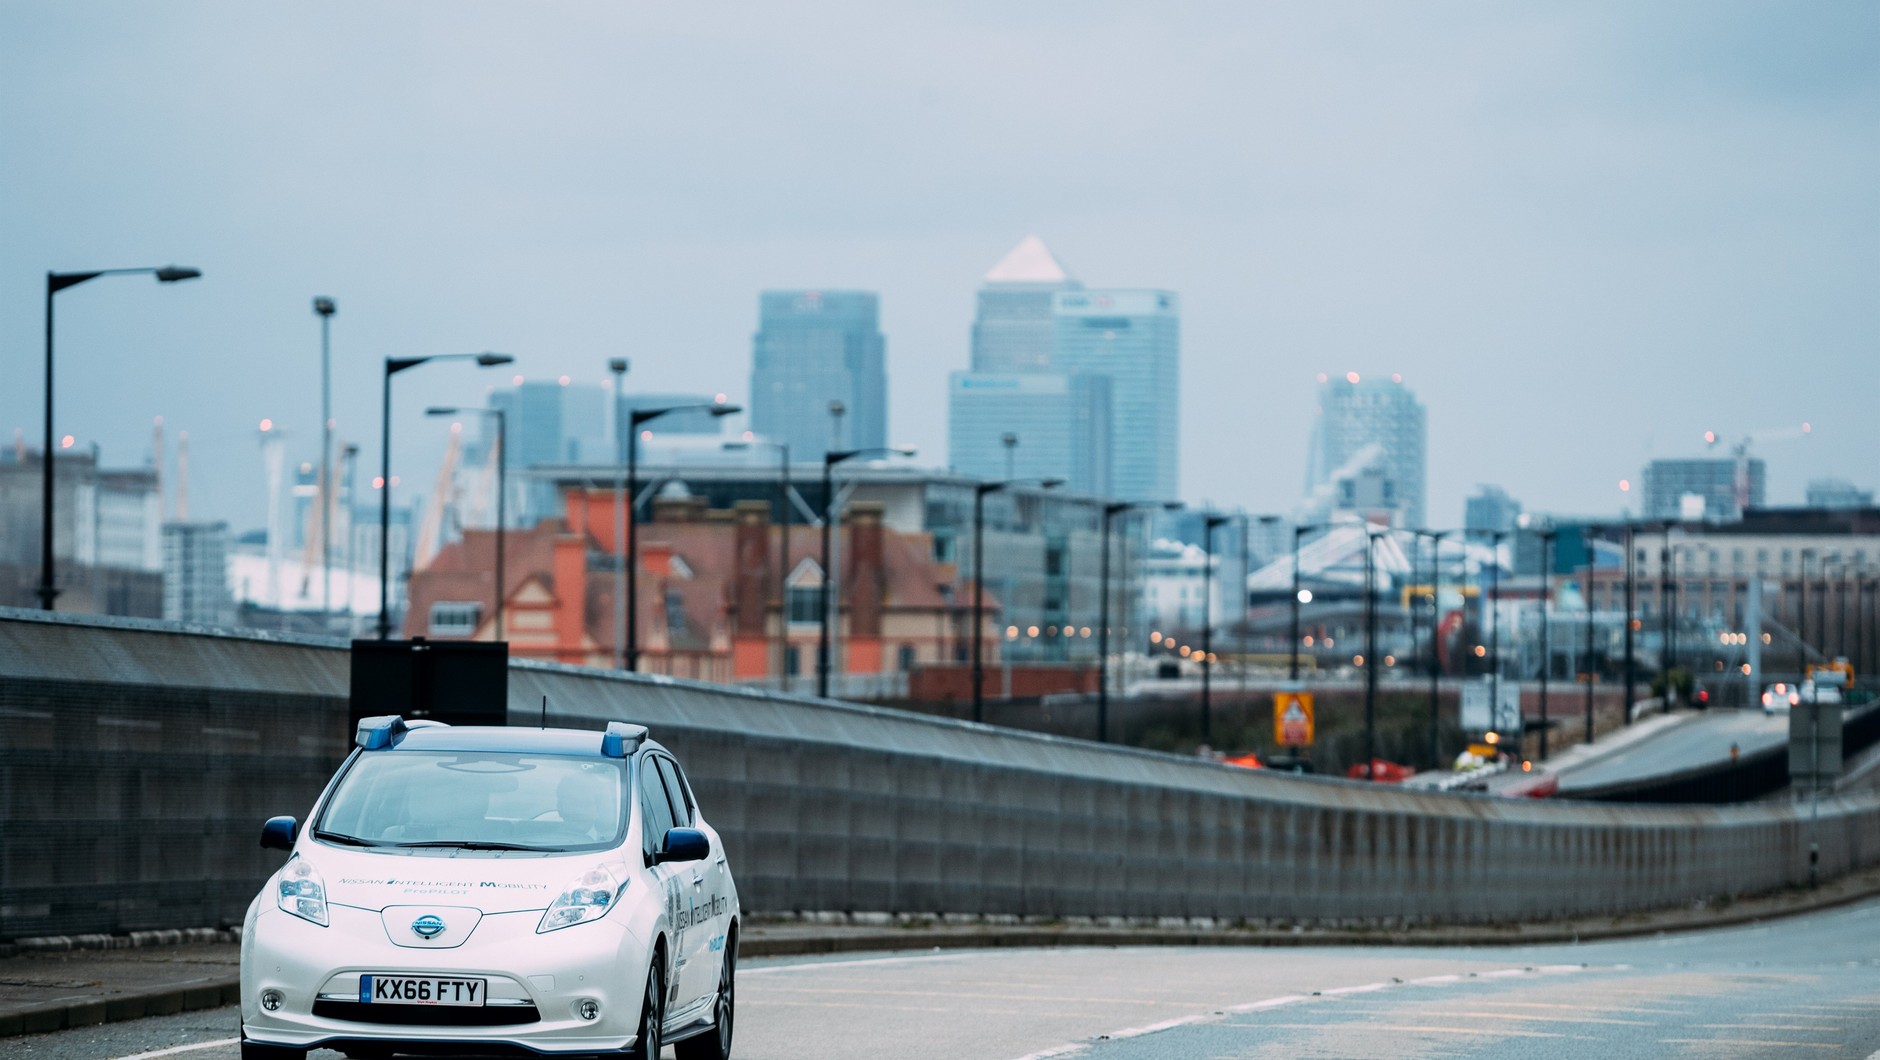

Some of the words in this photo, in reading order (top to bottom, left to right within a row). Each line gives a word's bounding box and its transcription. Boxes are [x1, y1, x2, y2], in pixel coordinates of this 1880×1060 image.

[387, 879, 473, 888] INTELLIGENT
[480, 881, 547, 891] MOBILITY
[375, 979, 431, 1000] KX66
[437, 981, 478, 1002] FTY
